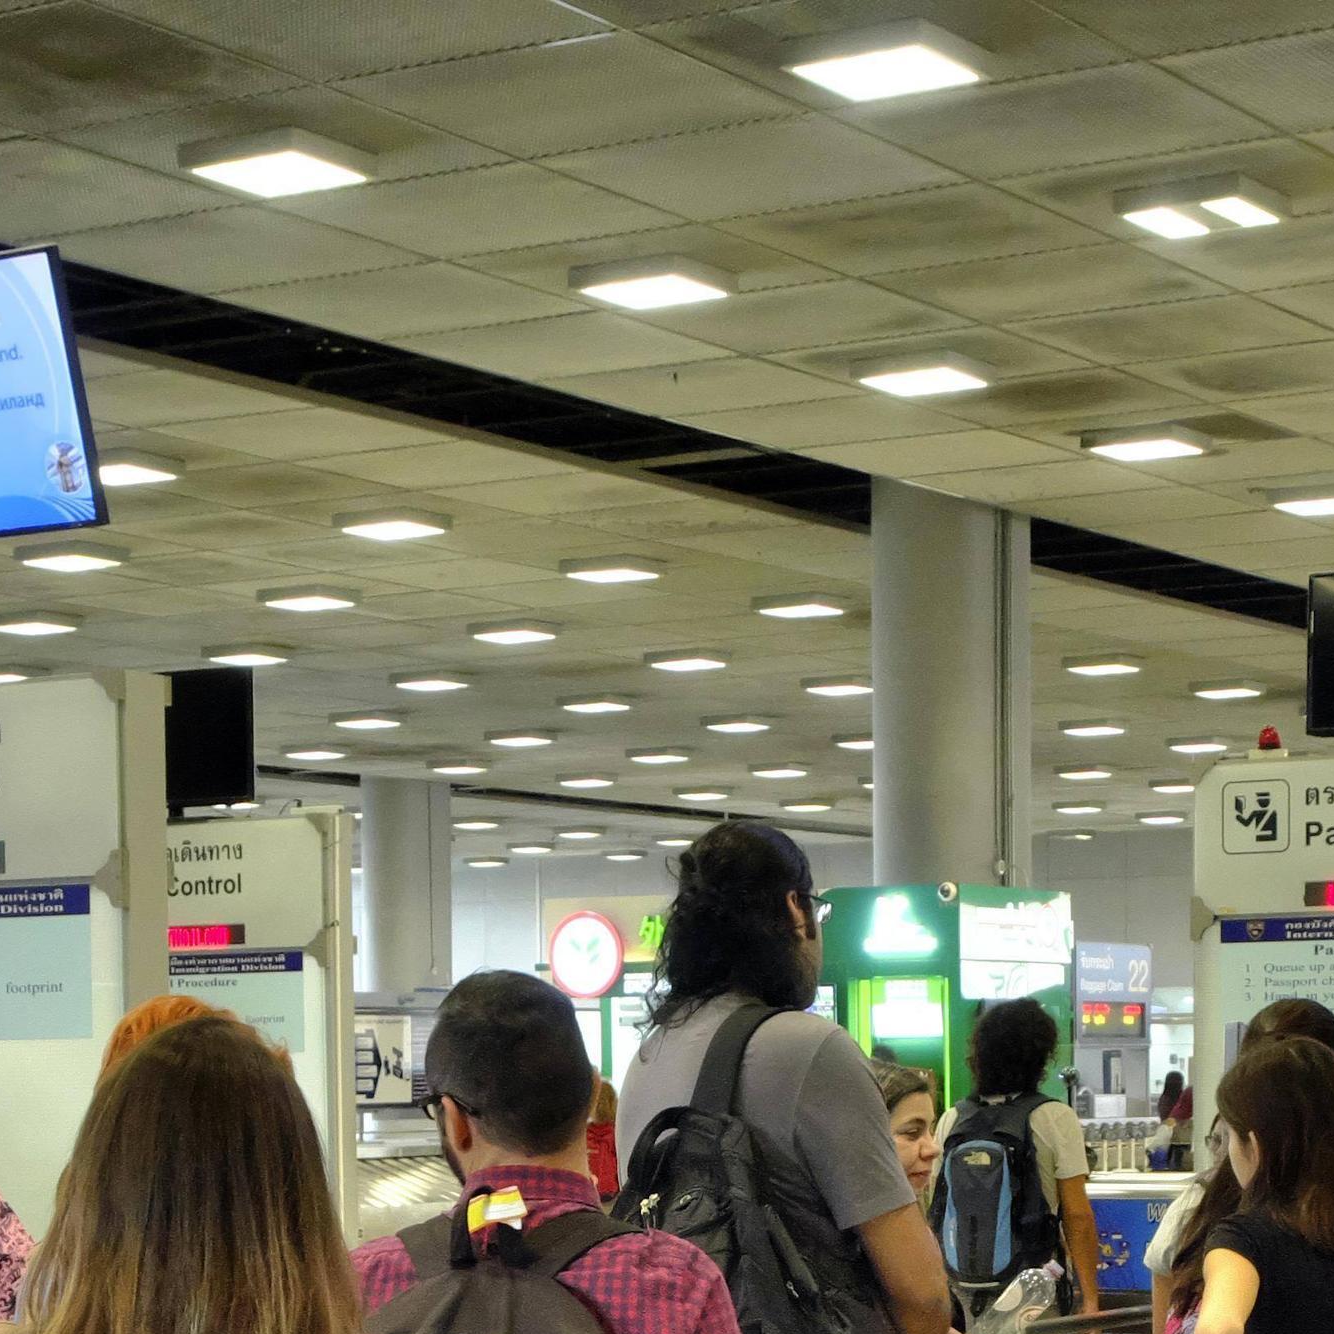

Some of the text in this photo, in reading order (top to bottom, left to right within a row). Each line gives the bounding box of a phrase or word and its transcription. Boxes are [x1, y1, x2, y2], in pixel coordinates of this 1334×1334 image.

[0, 903, 64, 915] Division
[1264, 962, 1305, 975] Queue
[1309, 964, 1325, 974] up
[1129, 959, 1149, 992] 22
[5, 981, 64, 996] footprint
[177, 978, 238, 988] Procedure
[1264, 977, 1317, 988] Passport
